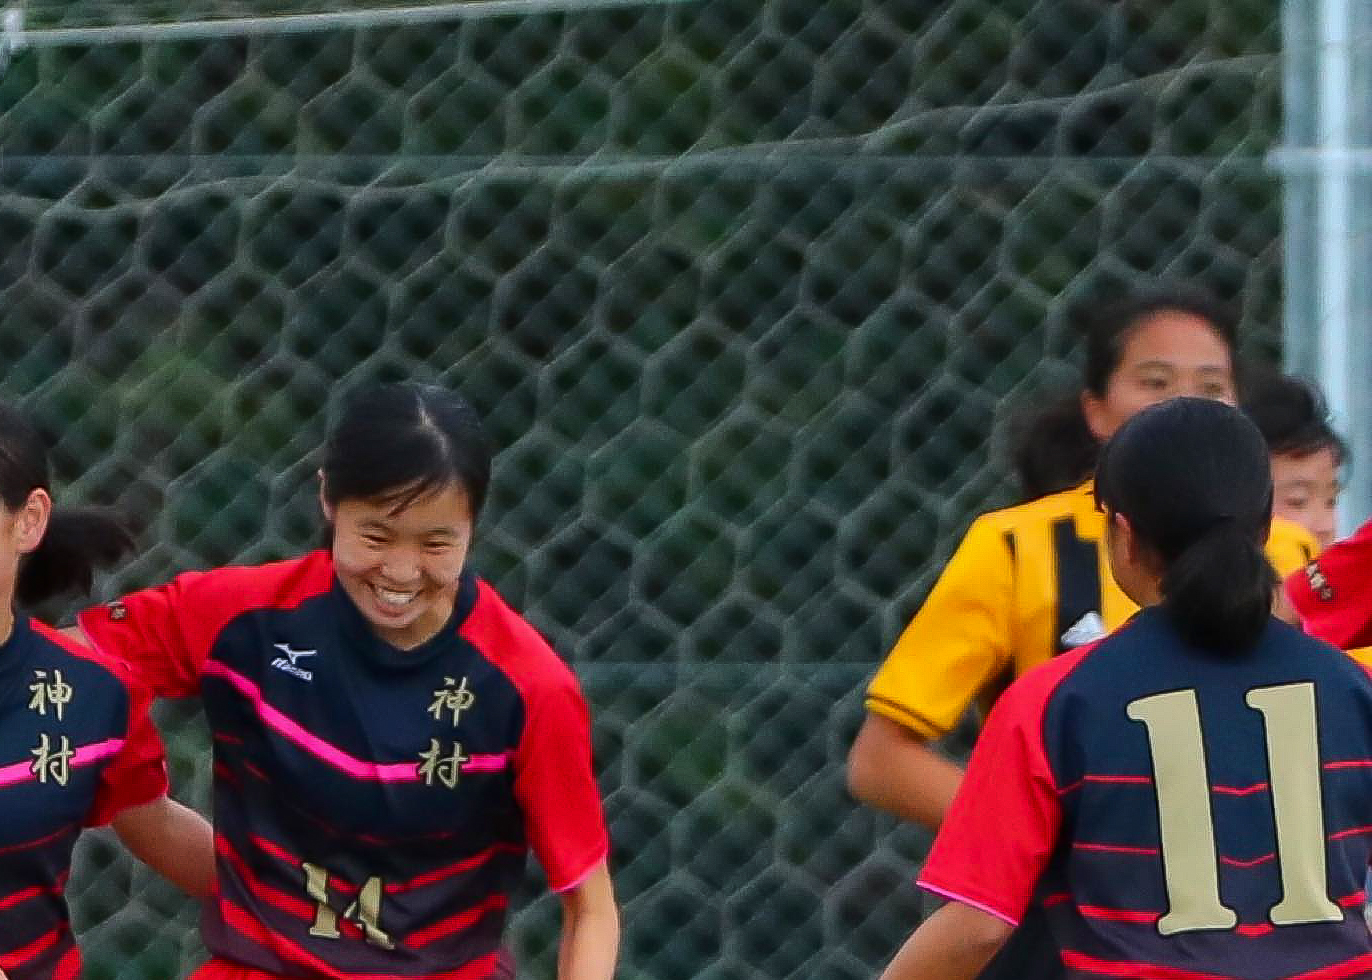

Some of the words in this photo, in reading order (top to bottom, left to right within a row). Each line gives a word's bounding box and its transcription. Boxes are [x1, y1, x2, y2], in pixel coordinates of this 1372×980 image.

[27, 668, 75, 787] 神村
[418, 676, 475, 790] 神村
[1126, 681, 1344, 936] 11
[302, 862, 396, 950] 14
